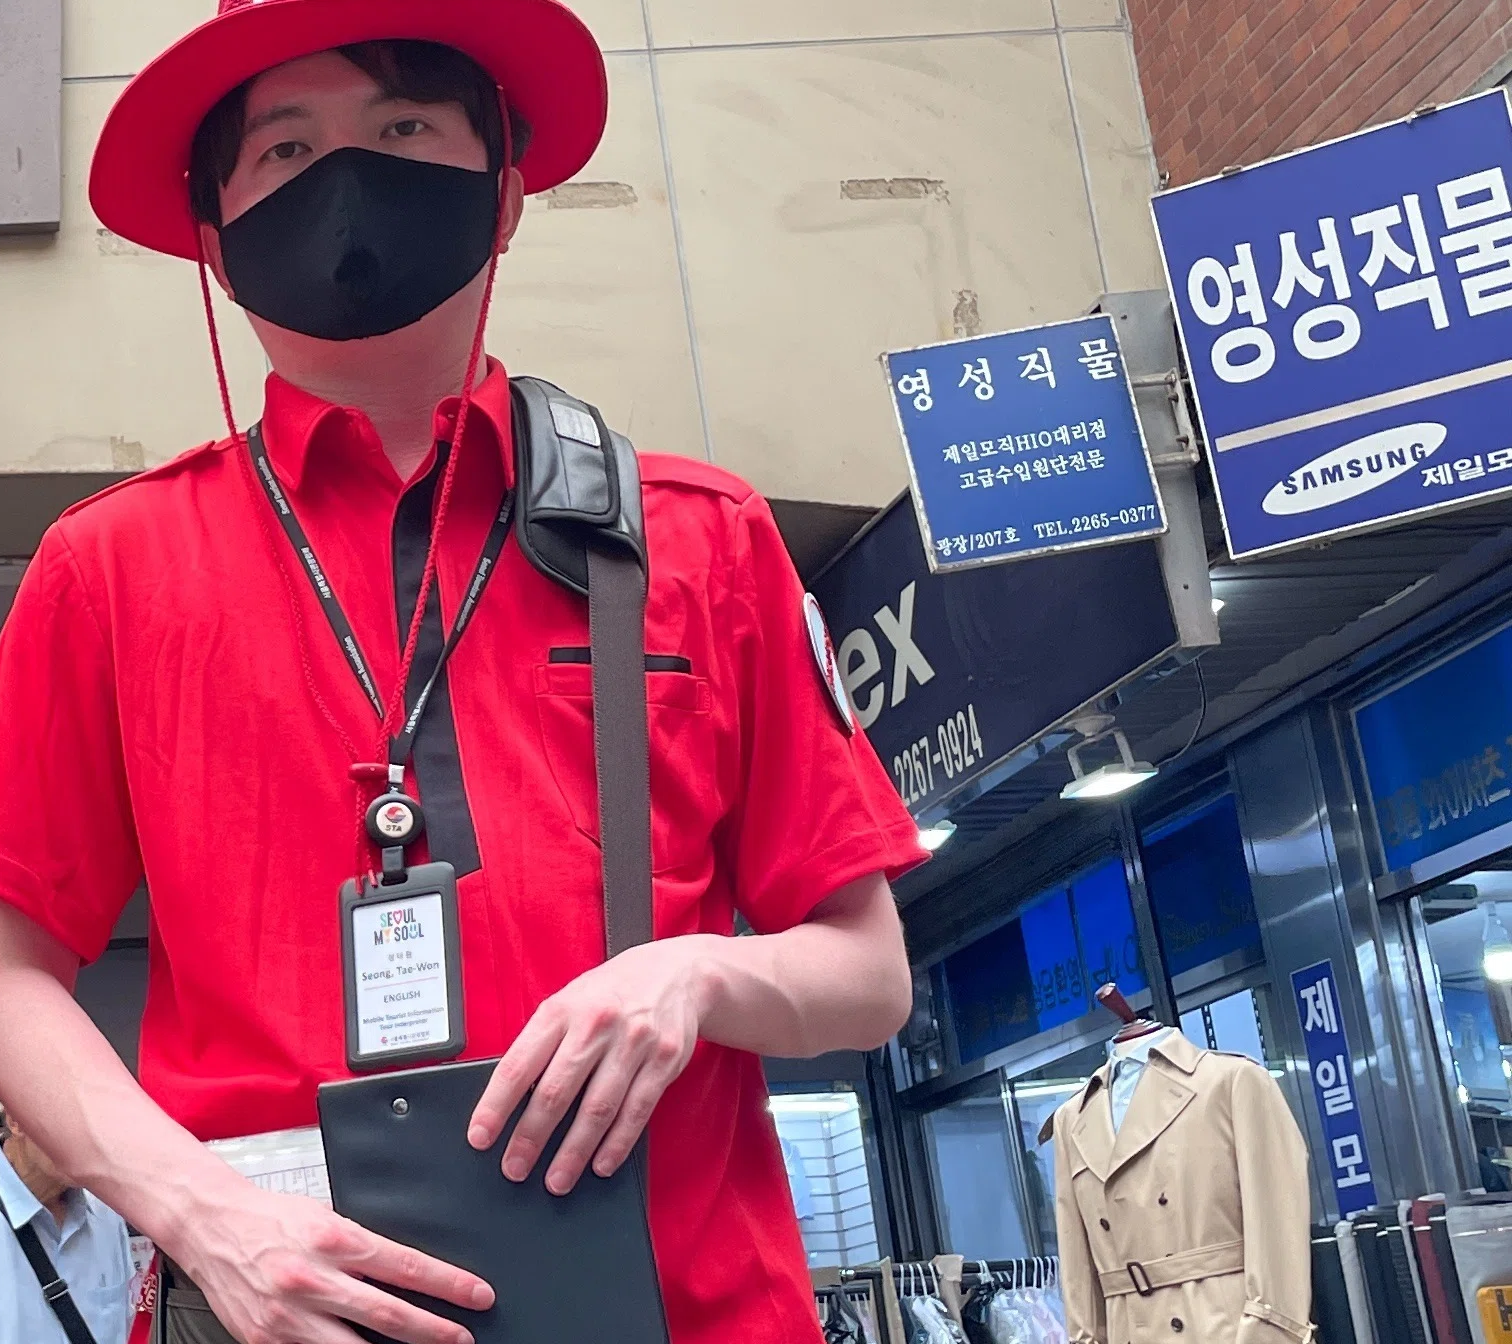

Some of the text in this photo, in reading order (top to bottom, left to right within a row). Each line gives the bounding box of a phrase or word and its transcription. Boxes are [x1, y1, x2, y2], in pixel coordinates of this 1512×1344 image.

[1188, 167, 1512, 383] 영성직물
[897, 338, 1118, 412] 영성직물
[1283, 442, 1512, 495] SAMSUNG 제일모
[1034, 504, 1156, 539] TEL.2265-0377
[894, 703, 984, 806] 2267-0924
[380, 908, 416, 928] SEOUL
[383, 990, 421, 1003] ENGLISH
[1300, 977, 1372, 1219] 제일모
